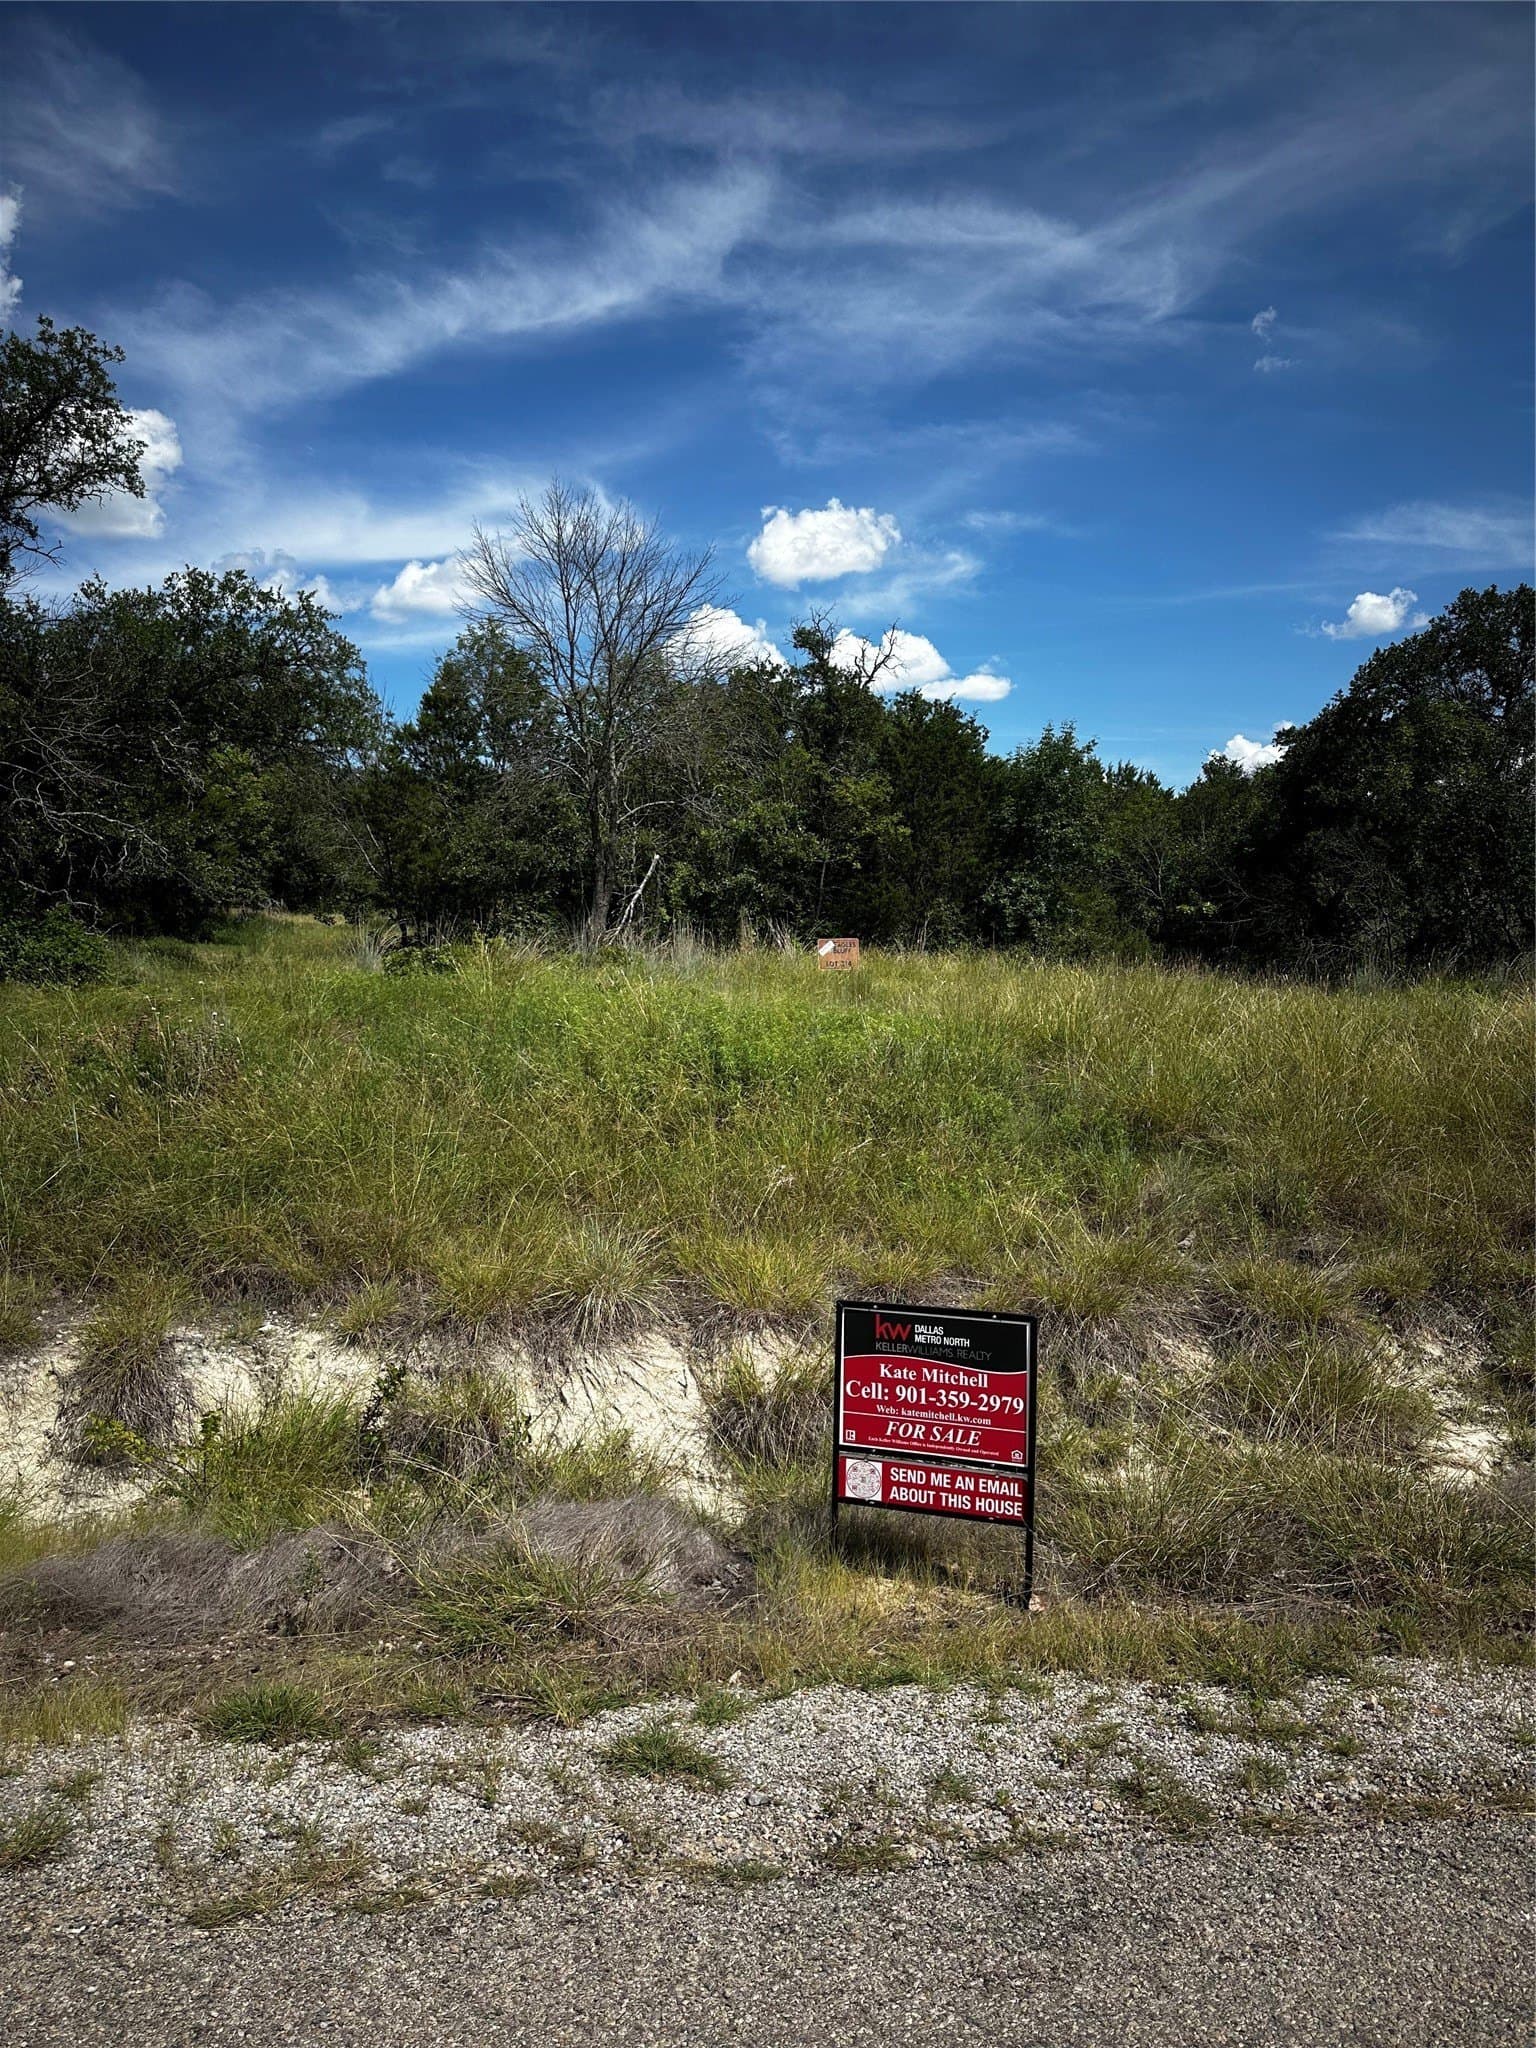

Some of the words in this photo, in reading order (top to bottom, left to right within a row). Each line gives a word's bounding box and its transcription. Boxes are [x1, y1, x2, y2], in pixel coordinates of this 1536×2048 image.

[875, 1313, 912, 1341] kw
[914, 1324, 944, 1336] DALLAS
[914, 1334, 942, 1345] METRO
[943, 1336, 970, 1348] NORTH
[957, 1349, 992, 1361] REALTY
[879, 1363, 917, 1381] Kate
[922, 1367, 988, 1388] Mitchell
[845, 1380, 889, 1401] Cell:
[895, 1385, 1025, 1415] 901-359-2979
[876, 1404, 899, 1416] Web:
[901, 1406, 992, 1426] katemitchell.kw.com
[885, 1420, 926, 1439] FOR
[930, 1426, 982, 1447] SALE
[890, 1467, 926, 1485] SEND
[930, 1472, 951, 1488] ME
[955, 1475, 975, 1492] AN
[979, 1478, 1023, 1498] EMAIL
[889, 1486, 936, 1505] ABOUT
[939, 1491, 971, 1510] THIS
[975, 1498, 1023, 1517] HOUSE
